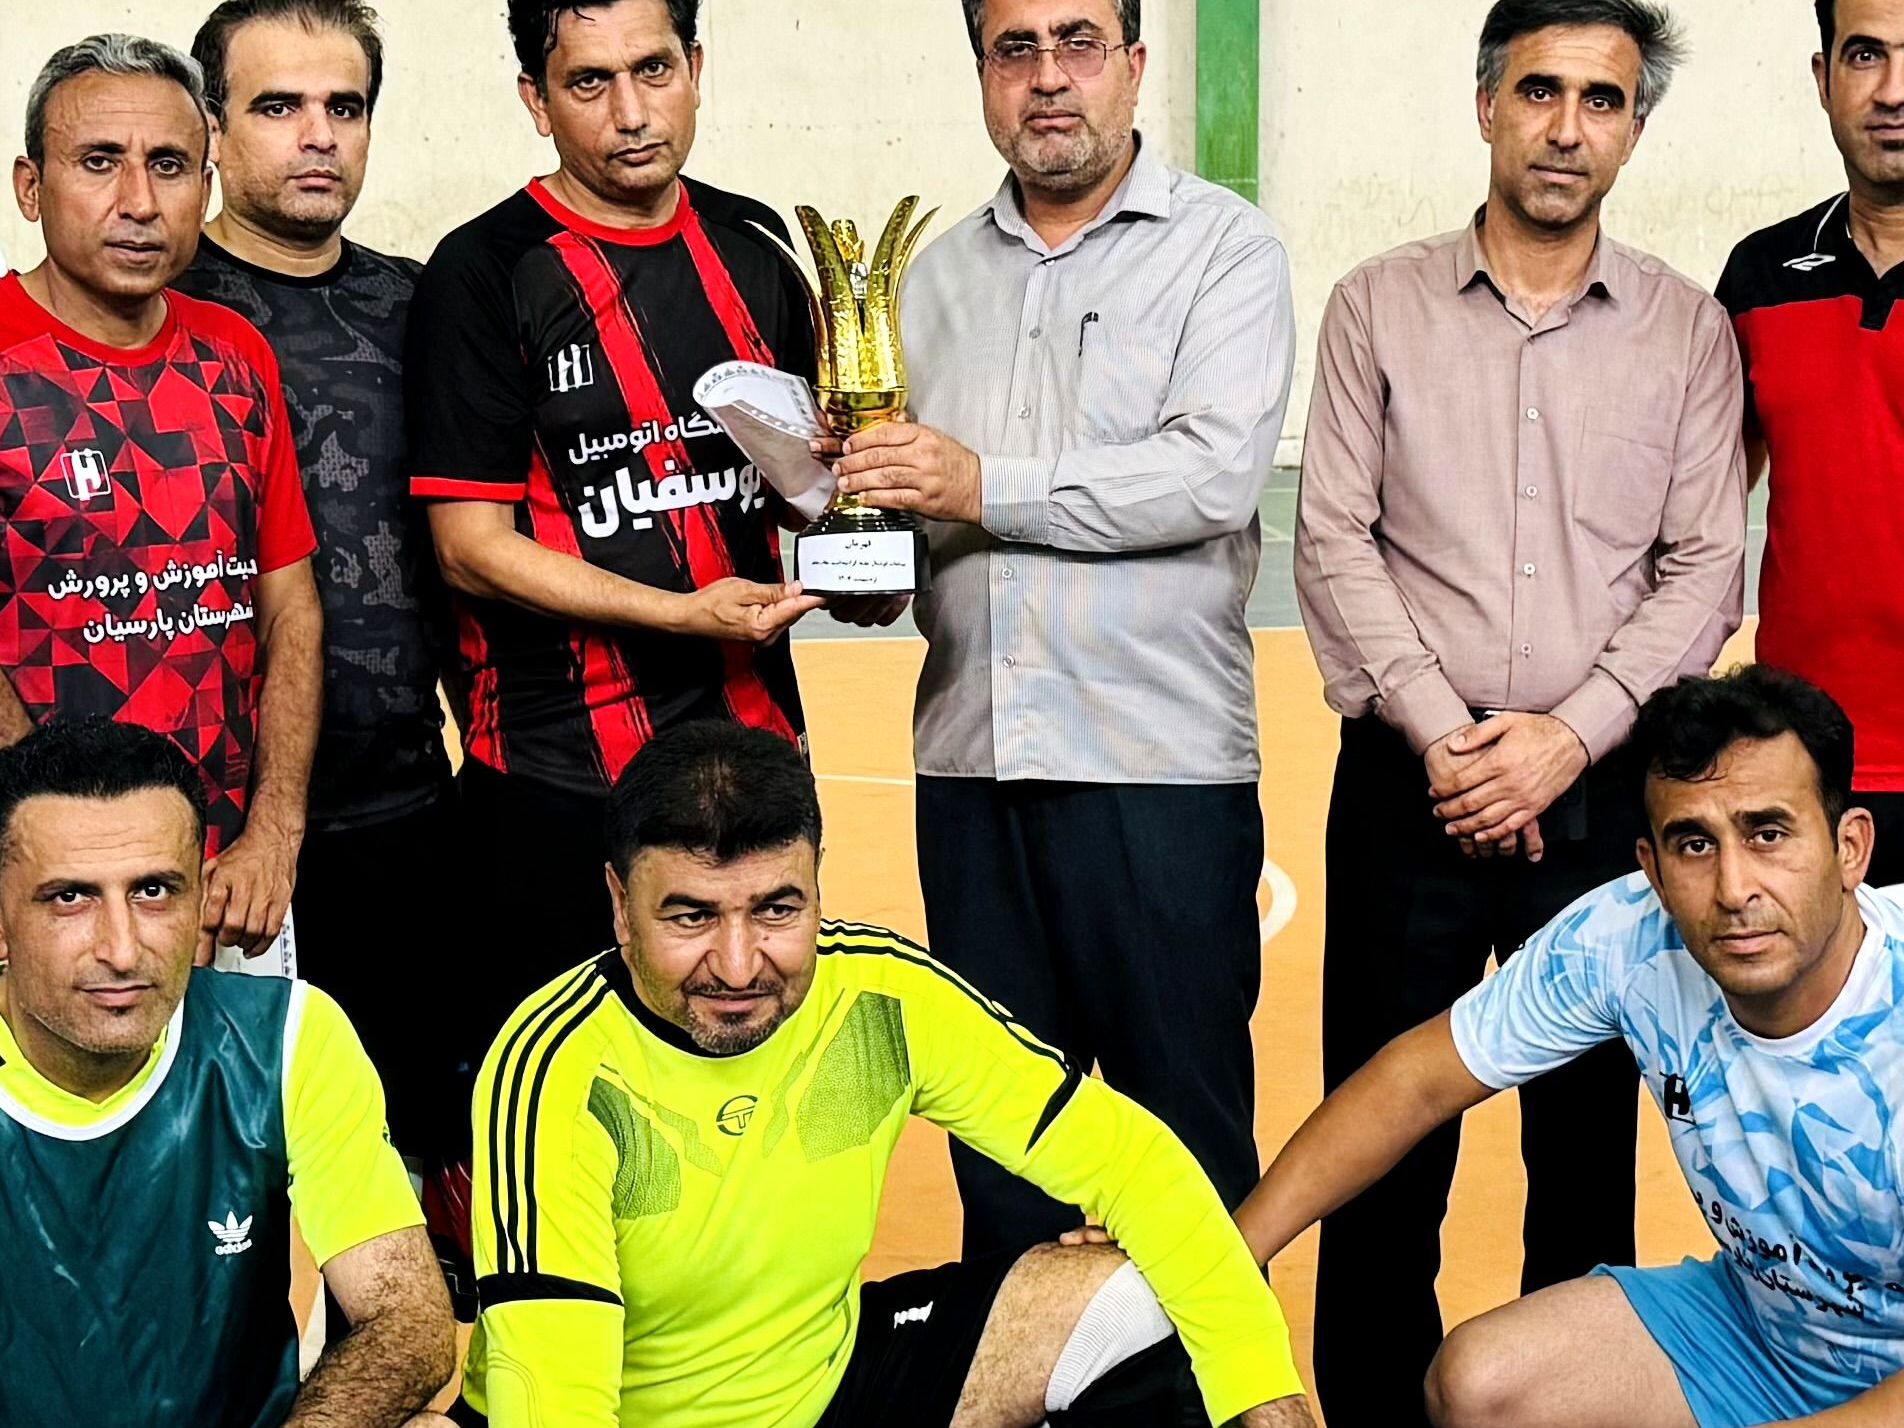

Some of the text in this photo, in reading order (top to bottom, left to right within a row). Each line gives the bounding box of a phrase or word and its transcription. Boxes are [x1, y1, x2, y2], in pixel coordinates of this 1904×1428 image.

[568, 420, 661, 465] اتومبیل
[47, 569, 130, 600] پرورش
[134, 571, 149, 594] و
[152, 549, 225, 590] آموزش
[82, 607, 175, 643] پارسیان
